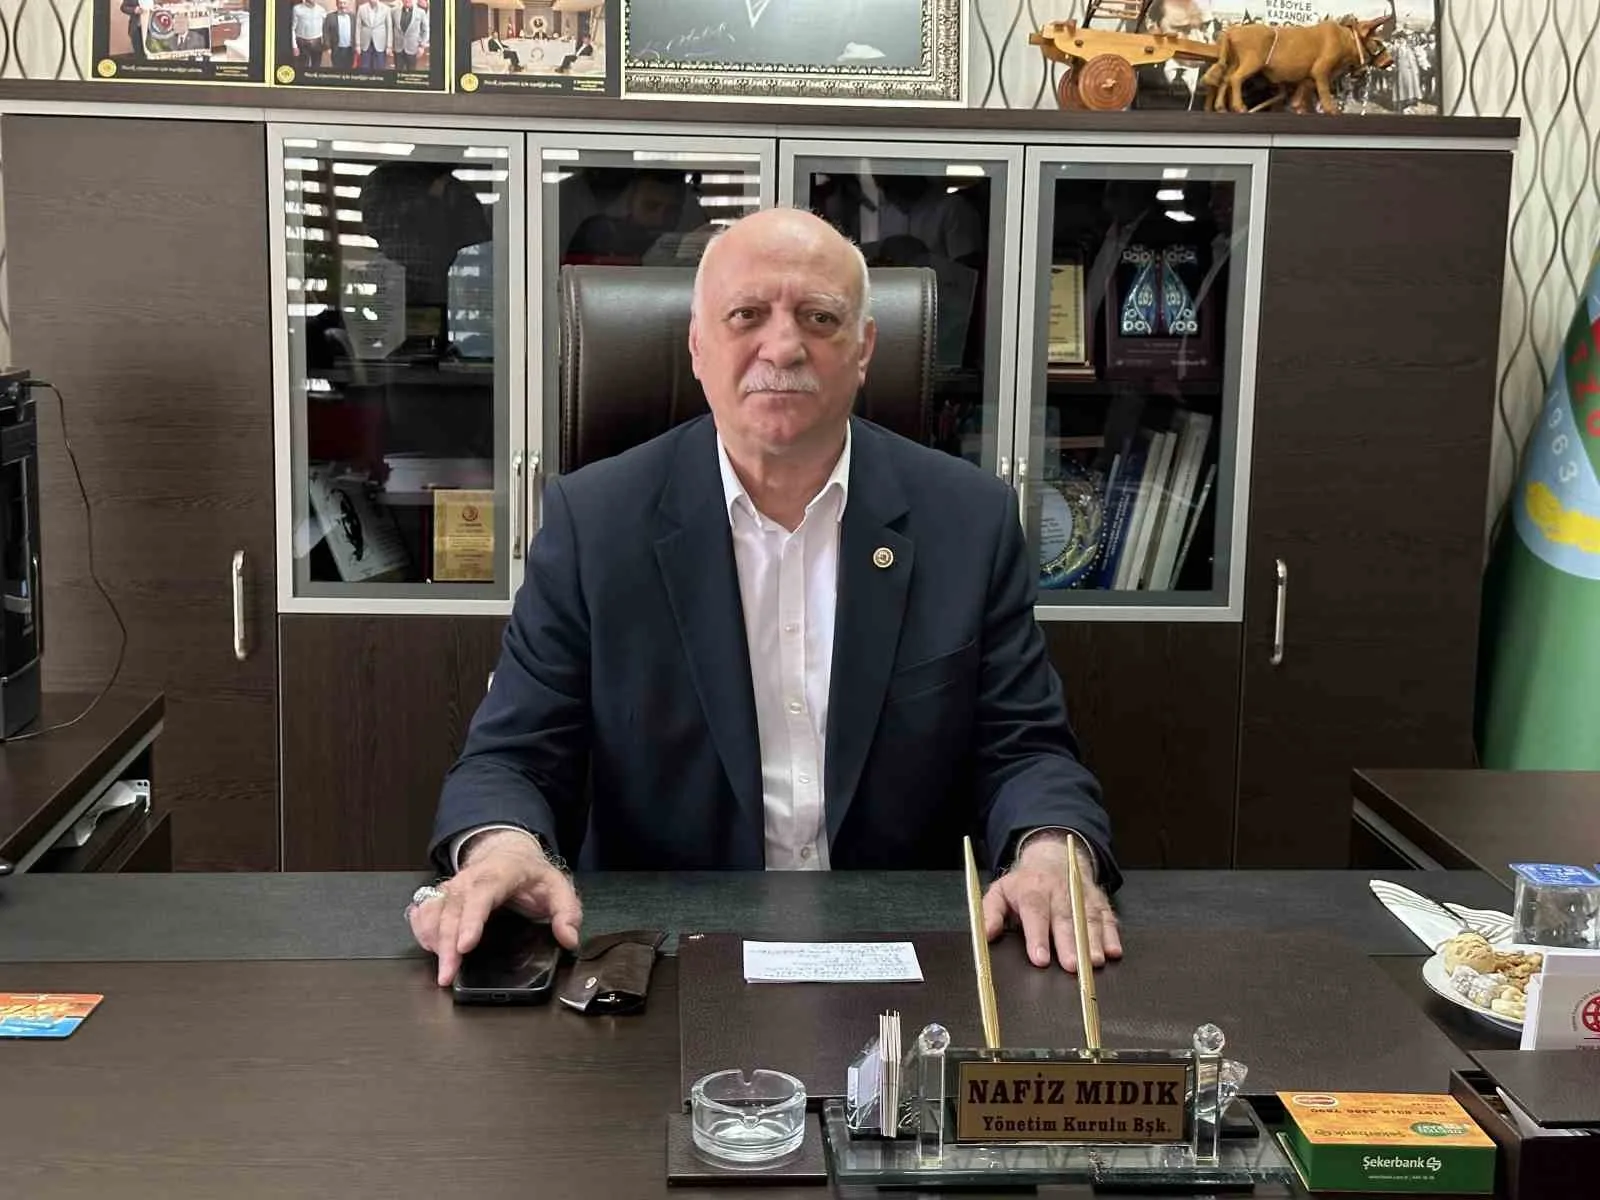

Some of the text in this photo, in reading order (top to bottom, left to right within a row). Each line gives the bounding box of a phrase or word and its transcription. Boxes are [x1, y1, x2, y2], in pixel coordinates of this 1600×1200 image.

[968, 1072, 1179, 1105] NAFİZ MIDIK
[983, 1116, 1172, 1137] Yönetim Kurulu Bşk.
[1362, 1155, 1425, 1170] Şekerbank
